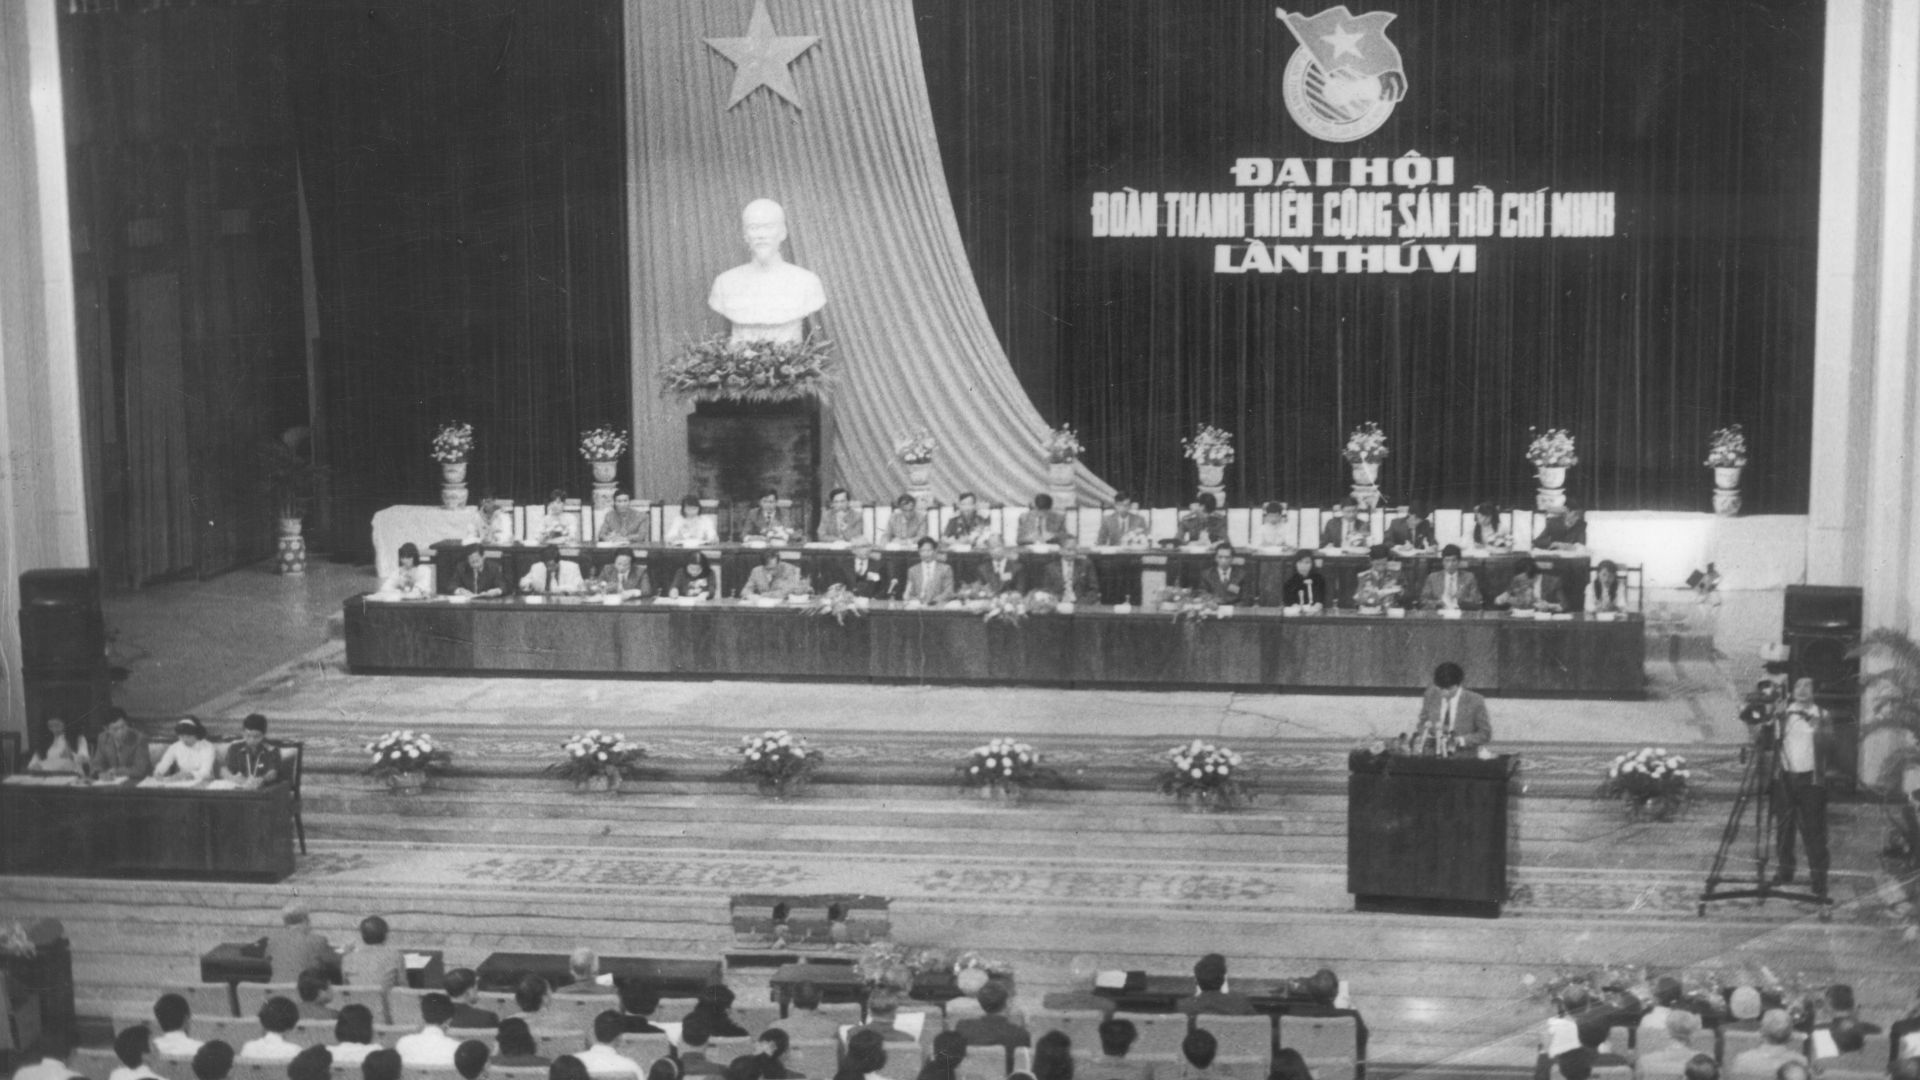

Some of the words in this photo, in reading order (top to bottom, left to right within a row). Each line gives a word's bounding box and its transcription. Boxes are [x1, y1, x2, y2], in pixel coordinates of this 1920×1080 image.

[1349, 149, 1454, 190] HỘI
[1091, 186, 1158, 237] ĐOÀN
[1164, 192, 1245, 237] THANH
[1253, 188, 1313, 237] NIÊN
[1323, 188, 1392, 240] CỘNG
[1458, 185, 1494, 237] HỒ
[1500, 186, 1549, 237] CHÍ
[1551, 192, 1616, 237] MINH
[1214, 238, 1309, 273] LẦN
[1423, 244, 1476, 273] VI
